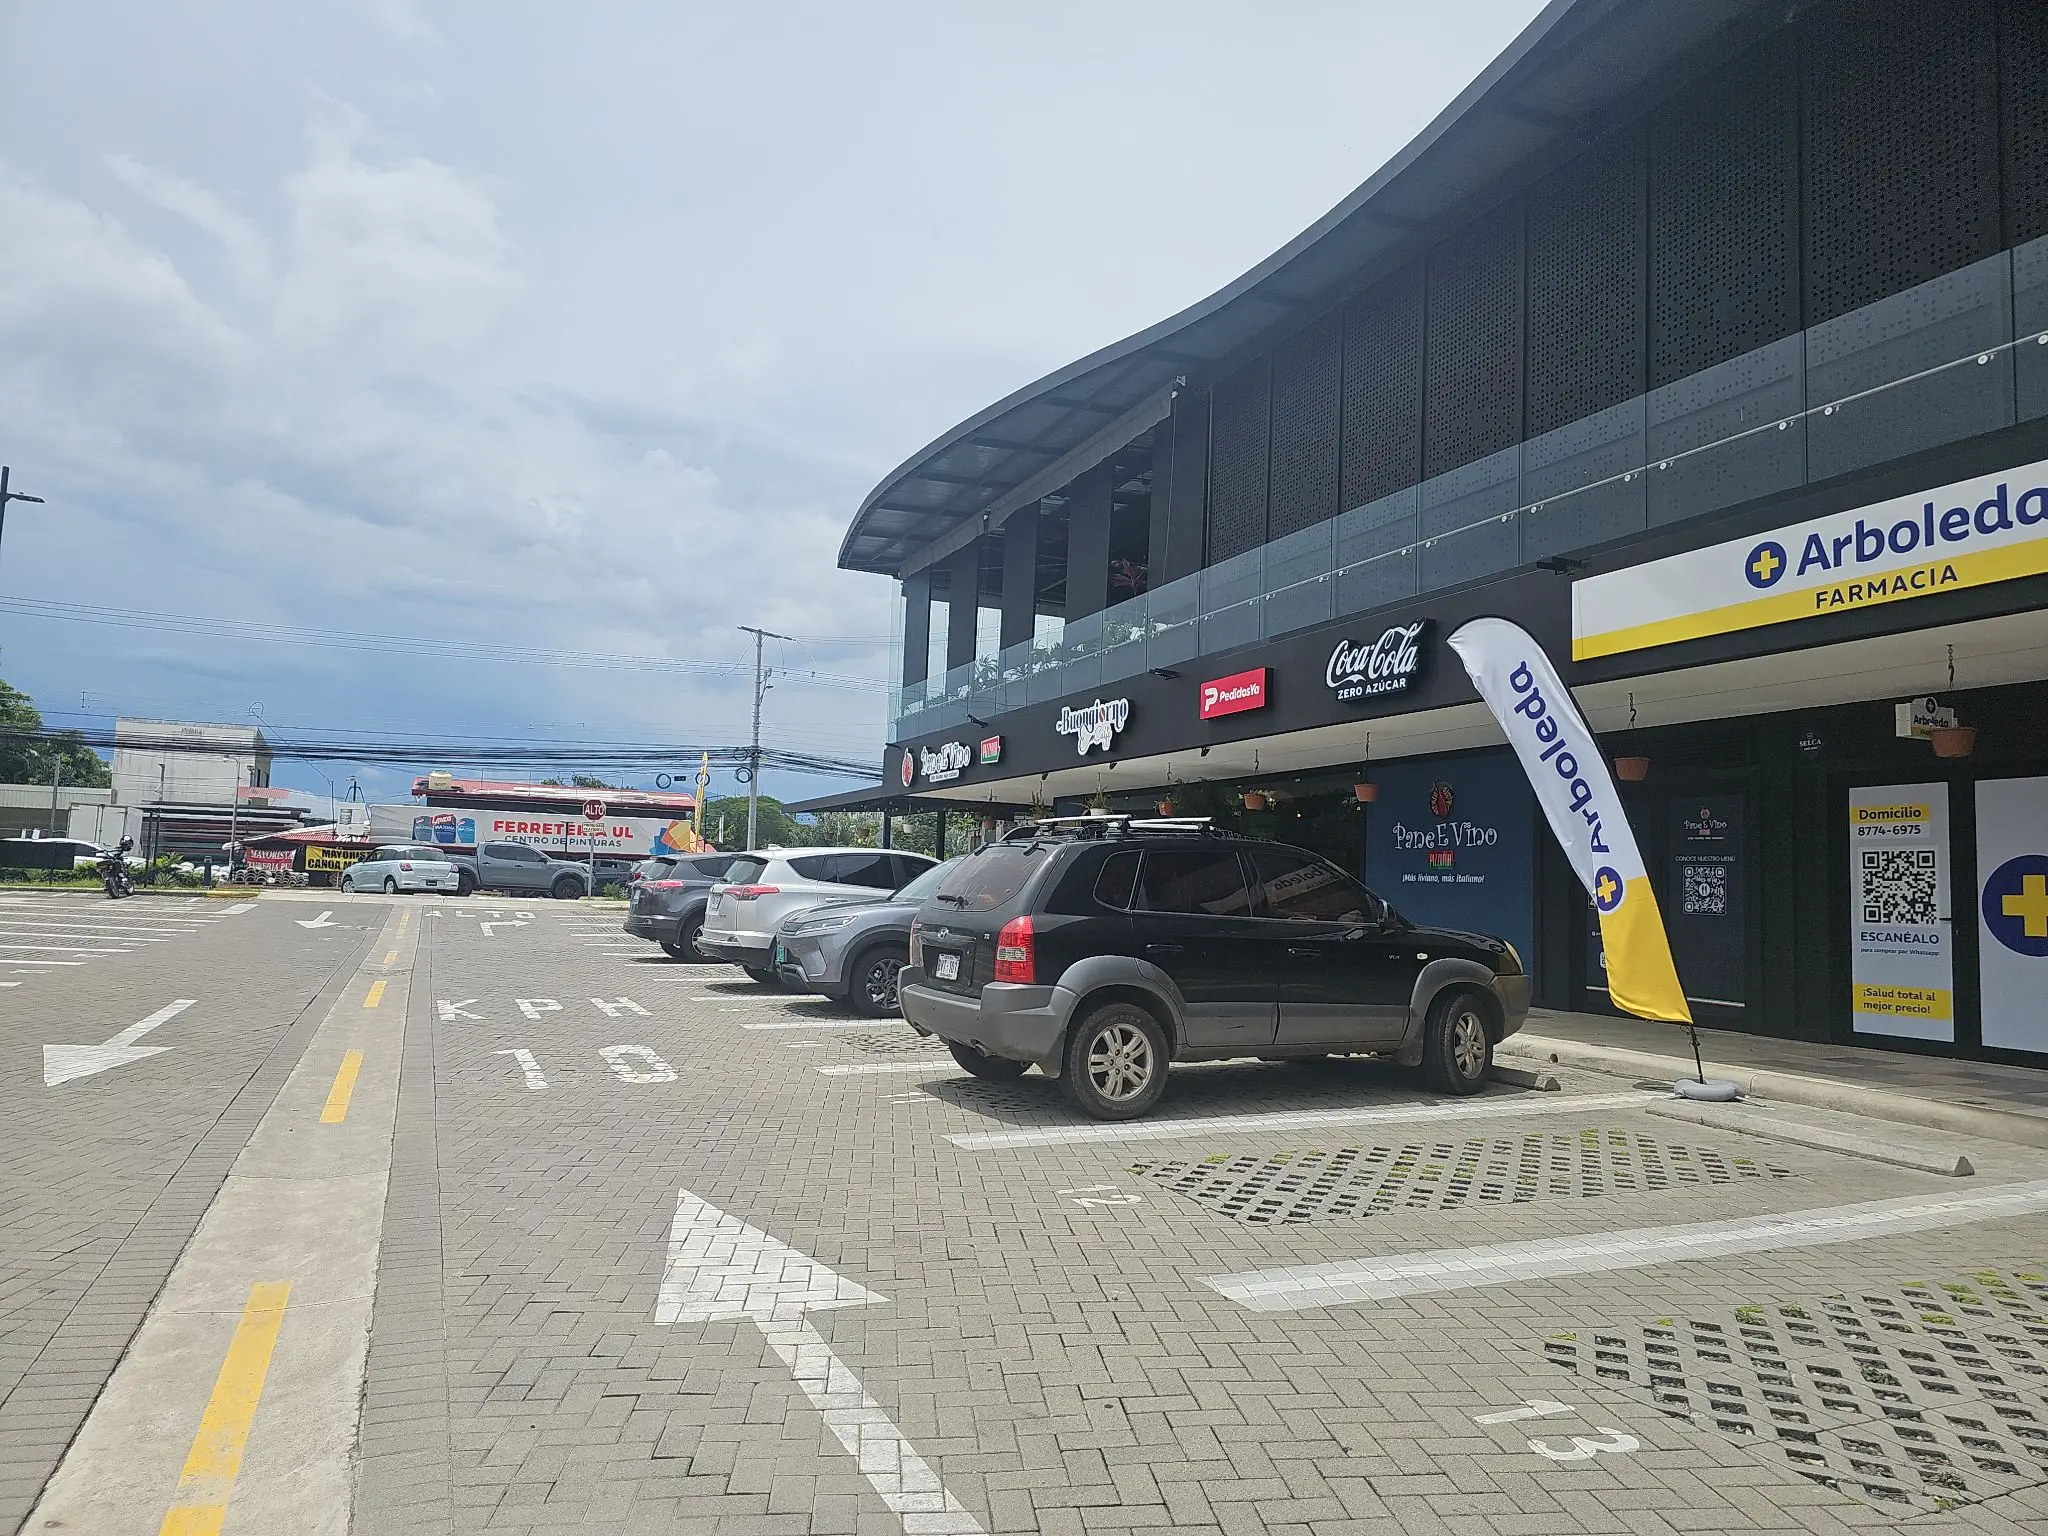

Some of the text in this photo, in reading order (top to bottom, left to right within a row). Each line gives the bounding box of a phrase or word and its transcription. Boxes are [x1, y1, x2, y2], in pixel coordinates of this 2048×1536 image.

[1796, 482, 2048, 576] Arboleda
[1815, 564, 1958, 609] FARMACIA
[1327, 621, 1424, 688] Coca-Cola
[1219, 683, 1260, 702] PedidosYa
[1338, 678, 1406, 700] ZERO AZÚCAR
[1509, 661, 1610, 853] Arboleda
[585, 804, 604, 815] ALTO
[1859, 806, 1922, 820] Domicilio
[1392, 821, 1498, 850] Pane E Vino
[1858, 825, 1921, 836] 8774-6975
[504, 835, 623, 848] CENTRO DE PINTURAS
[307, 859, 341, 870] CANOA
[1418, 873, 1440, 884] liviano,
[1441, 874, 1456, 882] más
[1456, 874, 1485, 884] italiano!
[424, 910, 537, 919] ALTO
[1861, 931, 1939, 944] ESCANÉALO
[1863, 988, 1936, 1002] ¡Salud total al
[1863, 1001, 1931, 1014] mejor precio!
[489, 1044, 679, 1090] 10
[1473, 1400, 1640, 1461] 13
